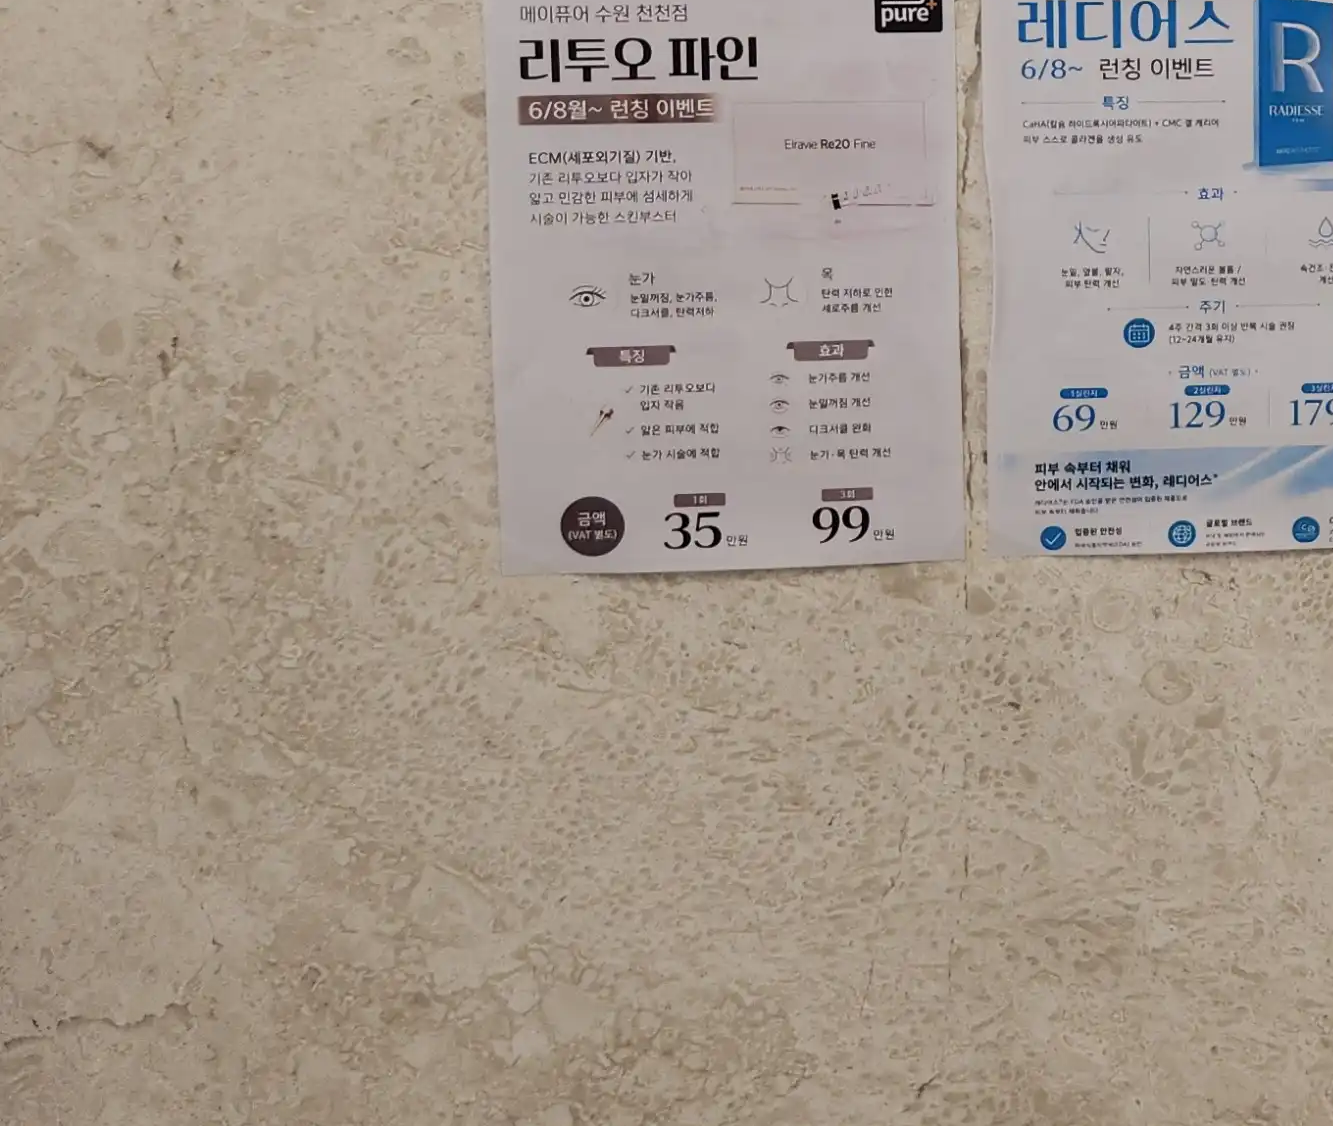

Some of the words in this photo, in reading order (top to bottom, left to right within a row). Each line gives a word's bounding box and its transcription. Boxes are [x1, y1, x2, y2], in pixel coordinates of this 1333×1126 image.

[520, 6, 588, 23] 메이퓨어
[596, 5, 629, 23] 수원
[637, 4, 687, 22] 천천점
[881, 5, 929, 28] pure
[1018, 0, 1234, 48] 레디어스
[520, 38, 656, 82] 리투오
[668, 37, 758, 80] 파인
[1271, 21, 1324, 93] R
[1021, 59, 1082, 80] 6/8~
[1100, 58, 1140, 80] 런칭
[1151, 57, 1214, 79] 이벤트
[528, 99, 602, 120] 6/8월~
[611, 99, 649, 119] 런칭
[656, 98, 714, 118] 이벤트
[1102, 96, 1128, 110] 특징
[1269, 105, 1324, 117] RADIESSE
[820, 139, 850, 149] Re20
[854, 139, 876, 149] Fine
[646, 150, 675, 163] 기반,
[530, 172, 554, 186] 기존
[626, 170, 662, 184] 입자가
[601, 191, 638, 203] 피부에
[1198, 188, 1224, 200] 효과
[531, 212, 568, 225] 시술이
[573, 211, 609, 224] 가능한
[614, 210, 676, 224] 스킨부스터
[629, 272, 655, 286] 눈가
[1200, 300, 1225, 314] 주기
[619, 349, 647, 365] 특징
[817, 341, 846, 357] 효과
[1179, 365, 1204, 379] 금액
[1053, 405, 1095, 431] 69
[1100, 420, 1117, 430] 만원
[1171, 401, 1225, 428] 129
[1229, 417, 1246, 426] 만원
[1035, 463, 1059, 476] 피부
[1064, 461, 1101, 474] 속부터
[1106, 460, 1130, 473] 채워
[1035, 478, 1072, 491] 안에서
[1076, 477, 1125, 490] 시작되는
[1130, 476, 1158, 490] 변화,
[578, 511, 606, 527] 금액
[813, 506, 870, 544] 99
[873, 529, 895, 541] 만원
[664, 512, 722, 549] 35
[726, 535, 748, 546] 만원
